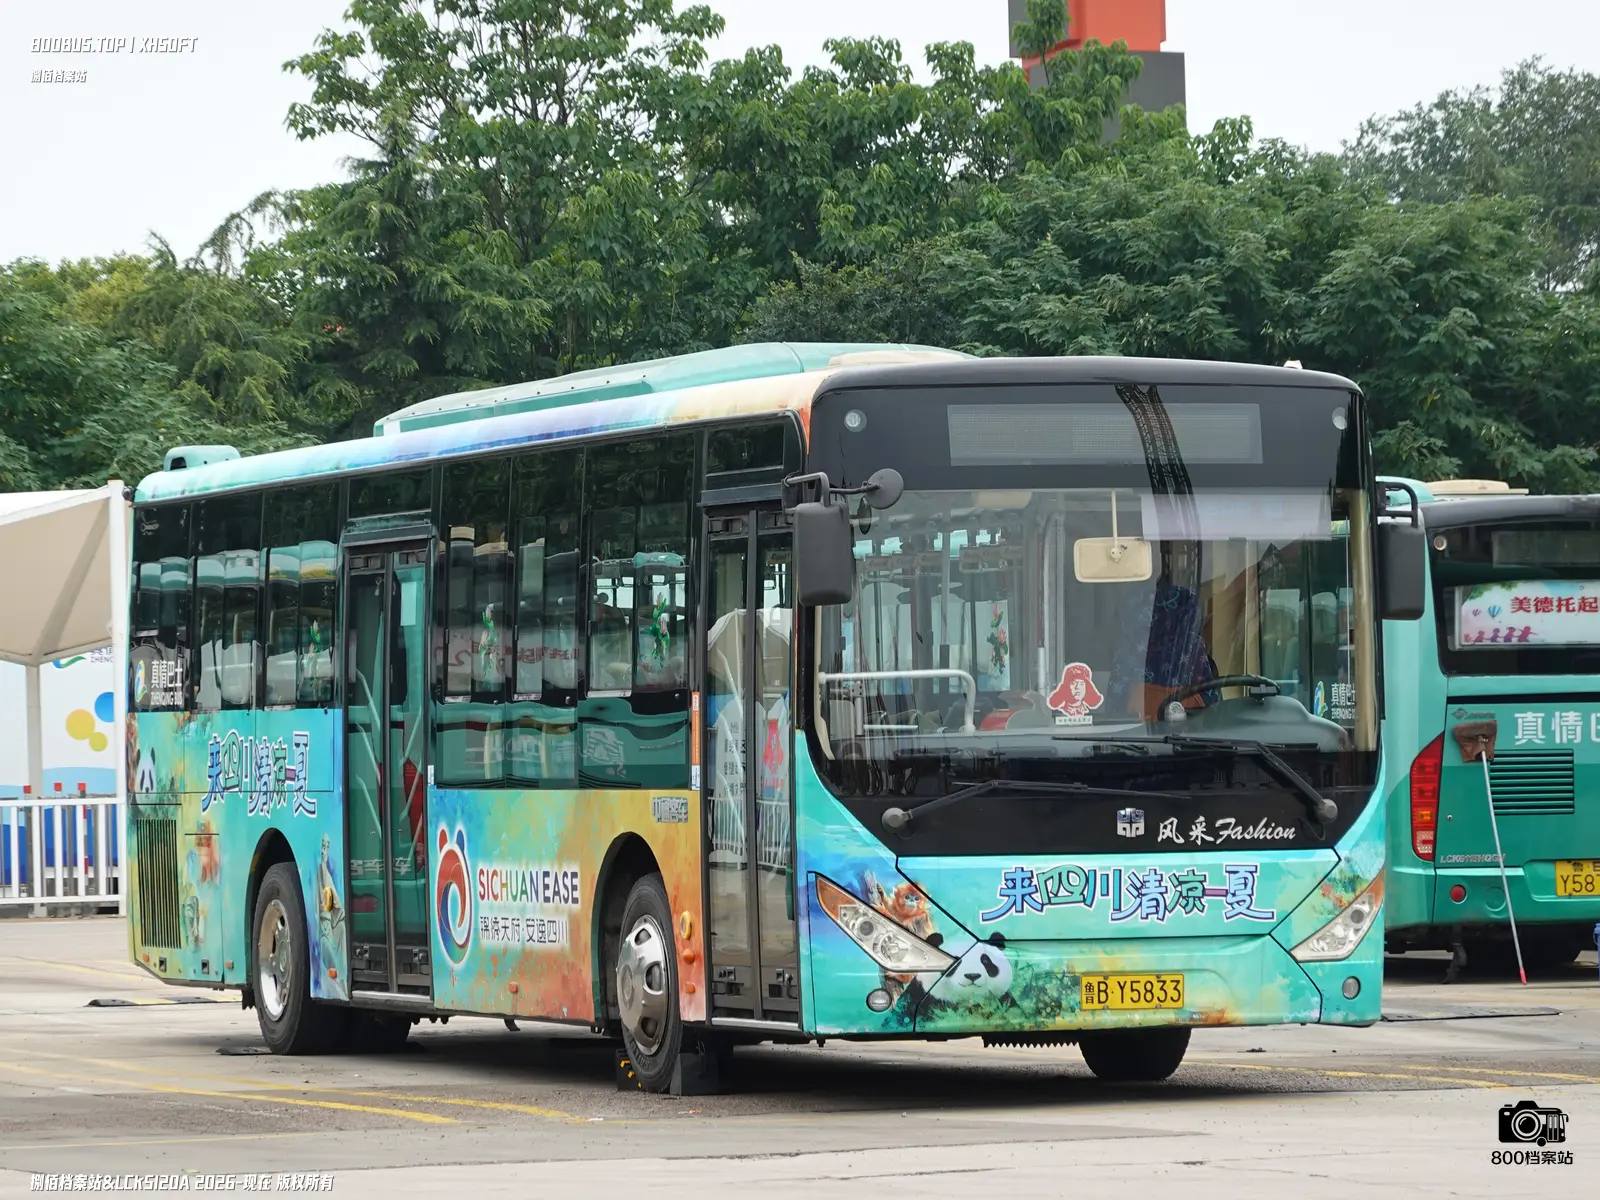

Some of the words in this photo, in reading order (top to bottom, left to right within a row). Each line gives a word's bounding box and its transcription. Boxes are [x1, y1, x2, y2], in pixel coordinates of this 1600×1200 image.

[1510, 596, 1600, 613] 美德托起
[151, 659, 183, 688] 真情巴士
[201, 729, 317, 819] 来四川清凉一夏
[1215, 817, 1296, 844] Fashion
[478, 868, 539, 903] SICHUAN
[542, 870, 579, 905] EASE
[980, 863, 1276, 923] 来四川清凉一夏
[1560, 874, 1600, 893] Y58
[1083, 979, 1182, 1005] 鲁B·Y5833
